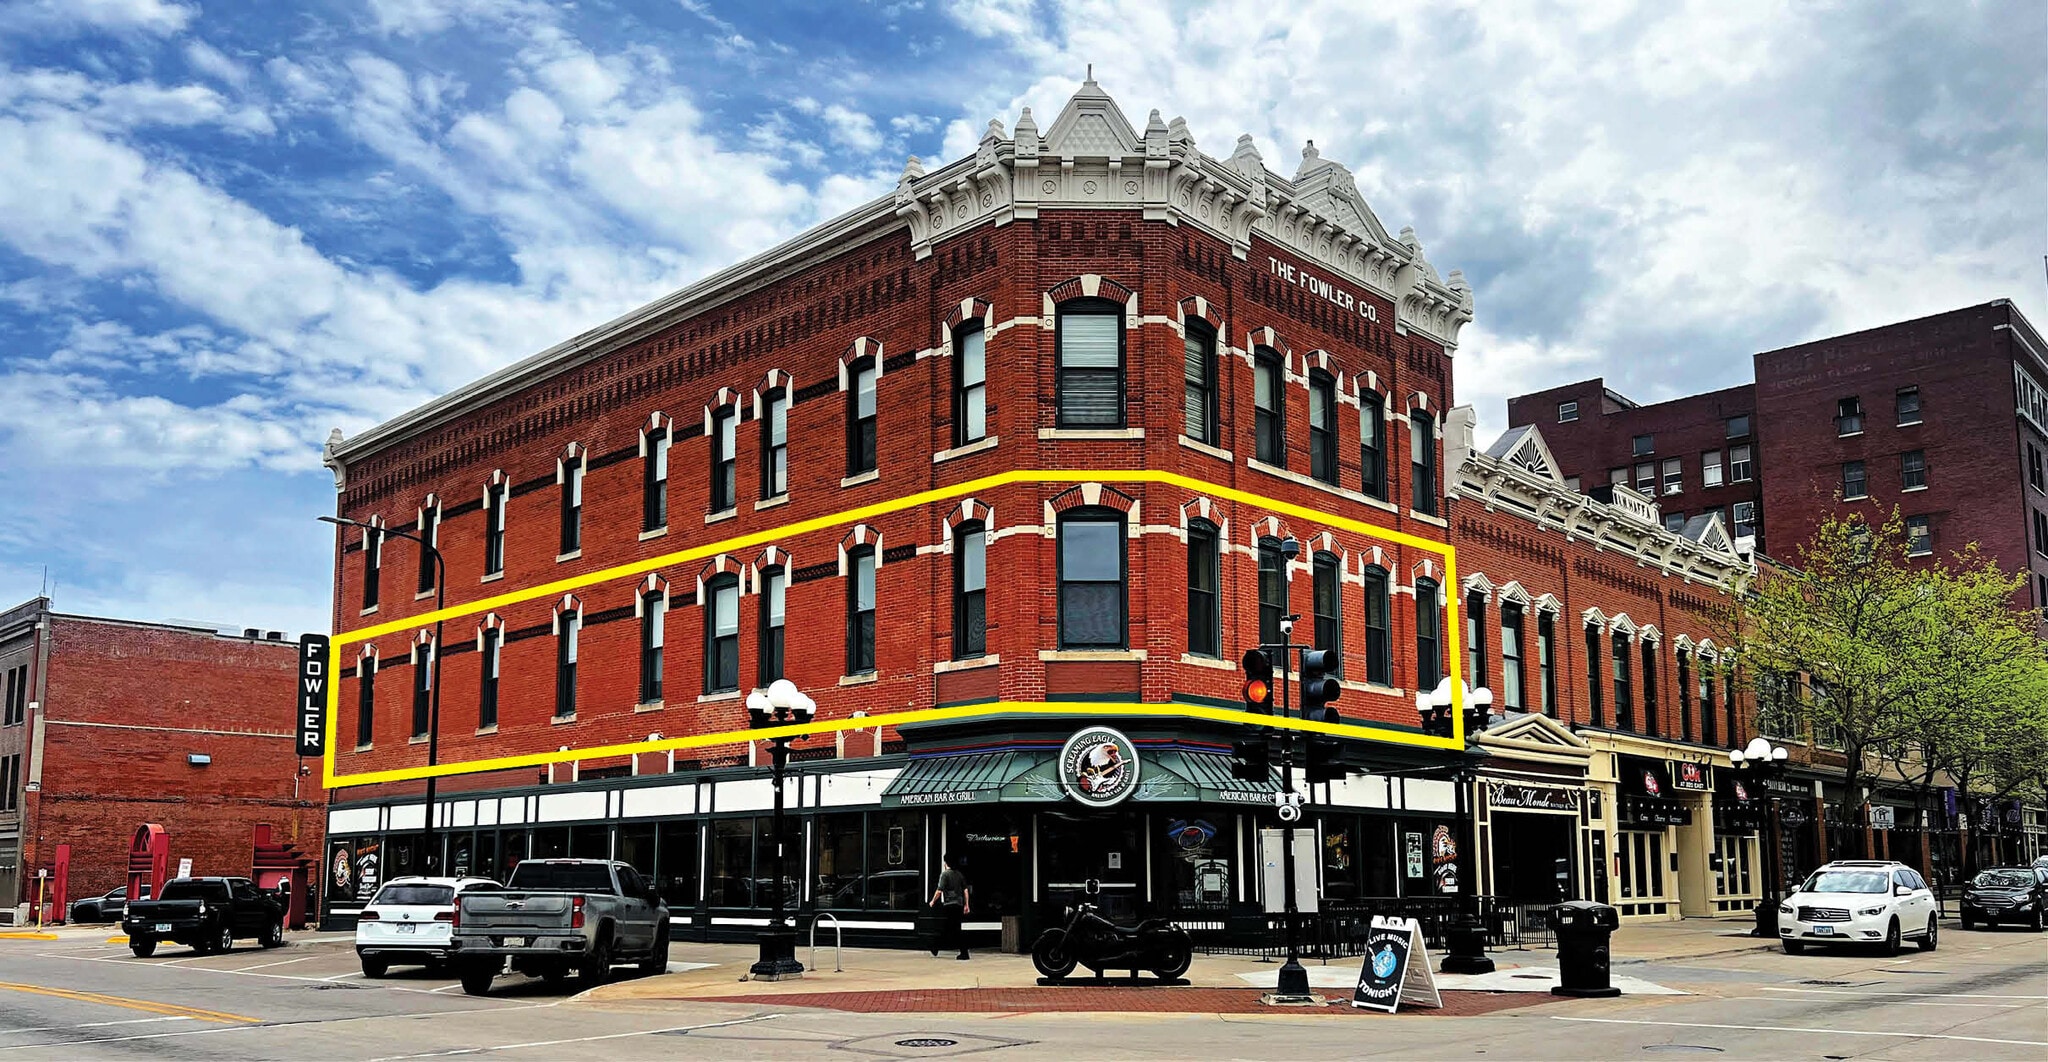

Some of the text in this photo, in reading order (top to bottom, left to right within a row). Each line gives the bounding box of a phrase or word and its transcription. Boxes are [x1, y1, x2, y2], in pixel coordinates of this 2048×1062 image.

[1268, 256, 1380, 324] THE FOWLER CO.
[304, 643, 322, 747] FOWLER
[1066, 735, 1116, 774] SCREAMING EAGLE
[900, 791, 976, 804] AMERICAN BAR & GRILL
[1220, 790, 1249, 801] AMERICAN
[1249, 792, 1260, 802] BAR
[1492, 785, 1516, 807] Beau
[1516, 789, 1550, 807] Monde
[1368, 933, 1409, 949] LIVE MUSIC
[1359, 979, 1398, 999] TONIGHT
